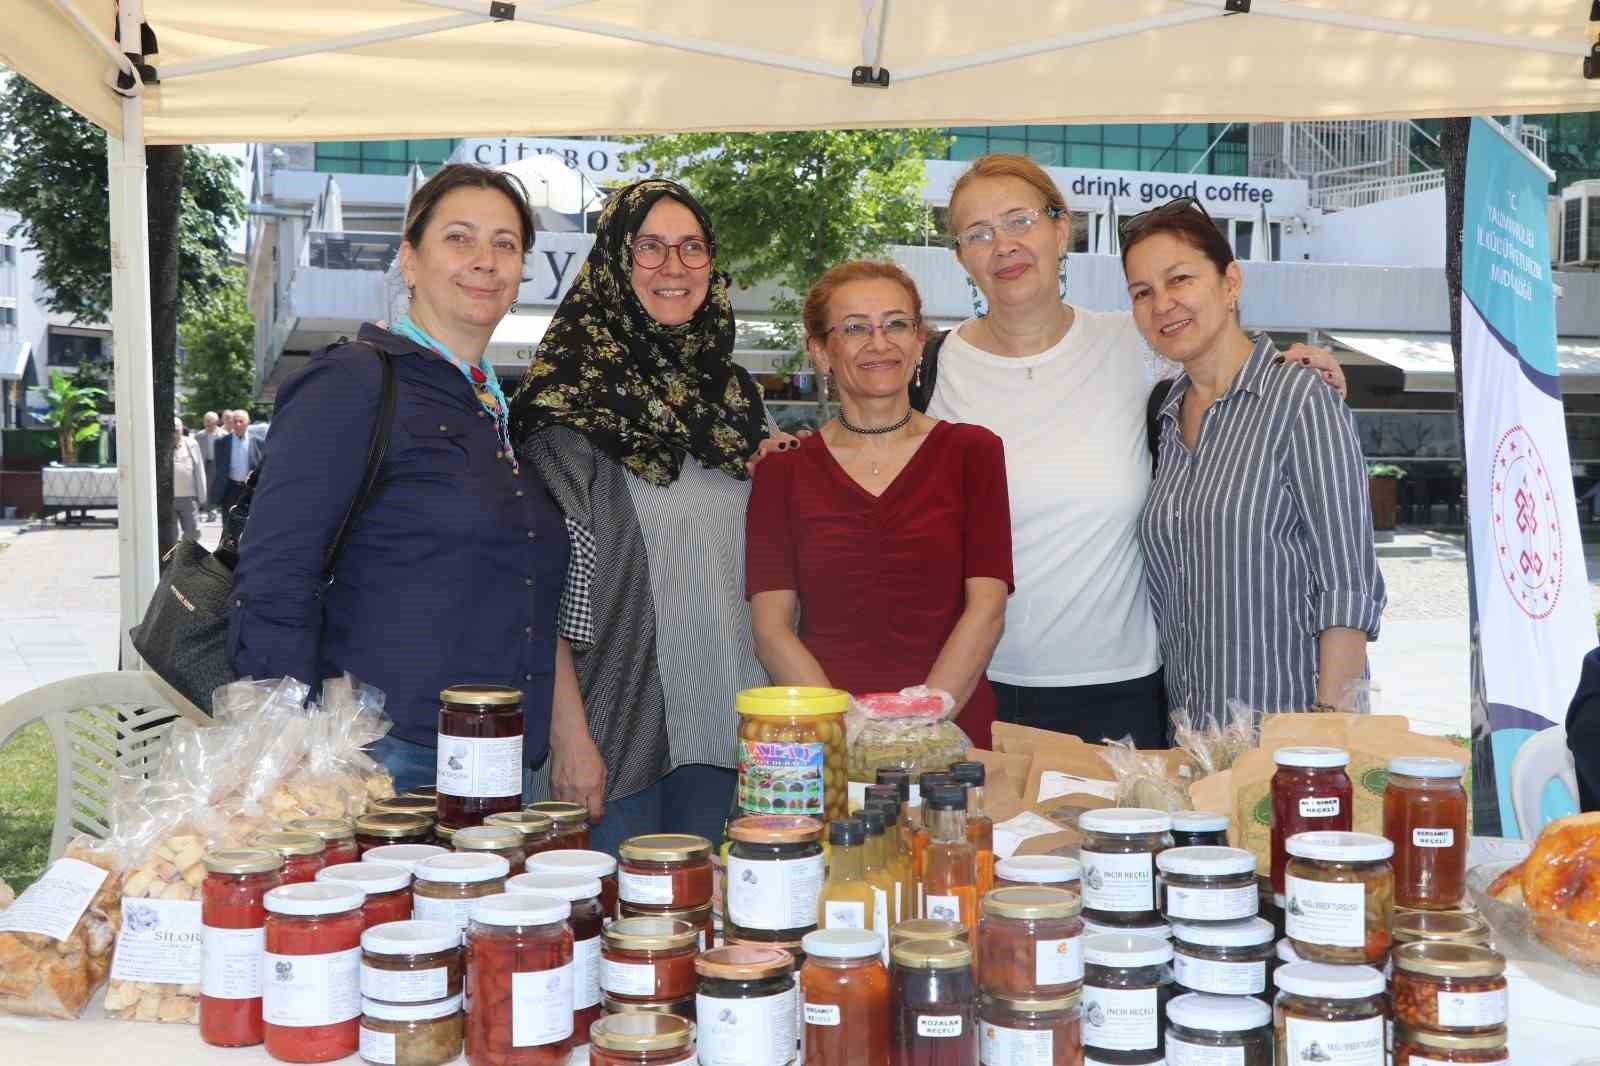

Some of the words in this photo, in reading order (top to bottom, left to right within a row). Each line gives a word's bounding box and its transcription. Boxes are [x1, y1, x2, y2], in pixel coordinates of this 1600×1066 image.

[1072, 175, 1130, 197] drink
[1140, 180, 1198, 203] good
[1205, 182, 1273, 204] coffee
